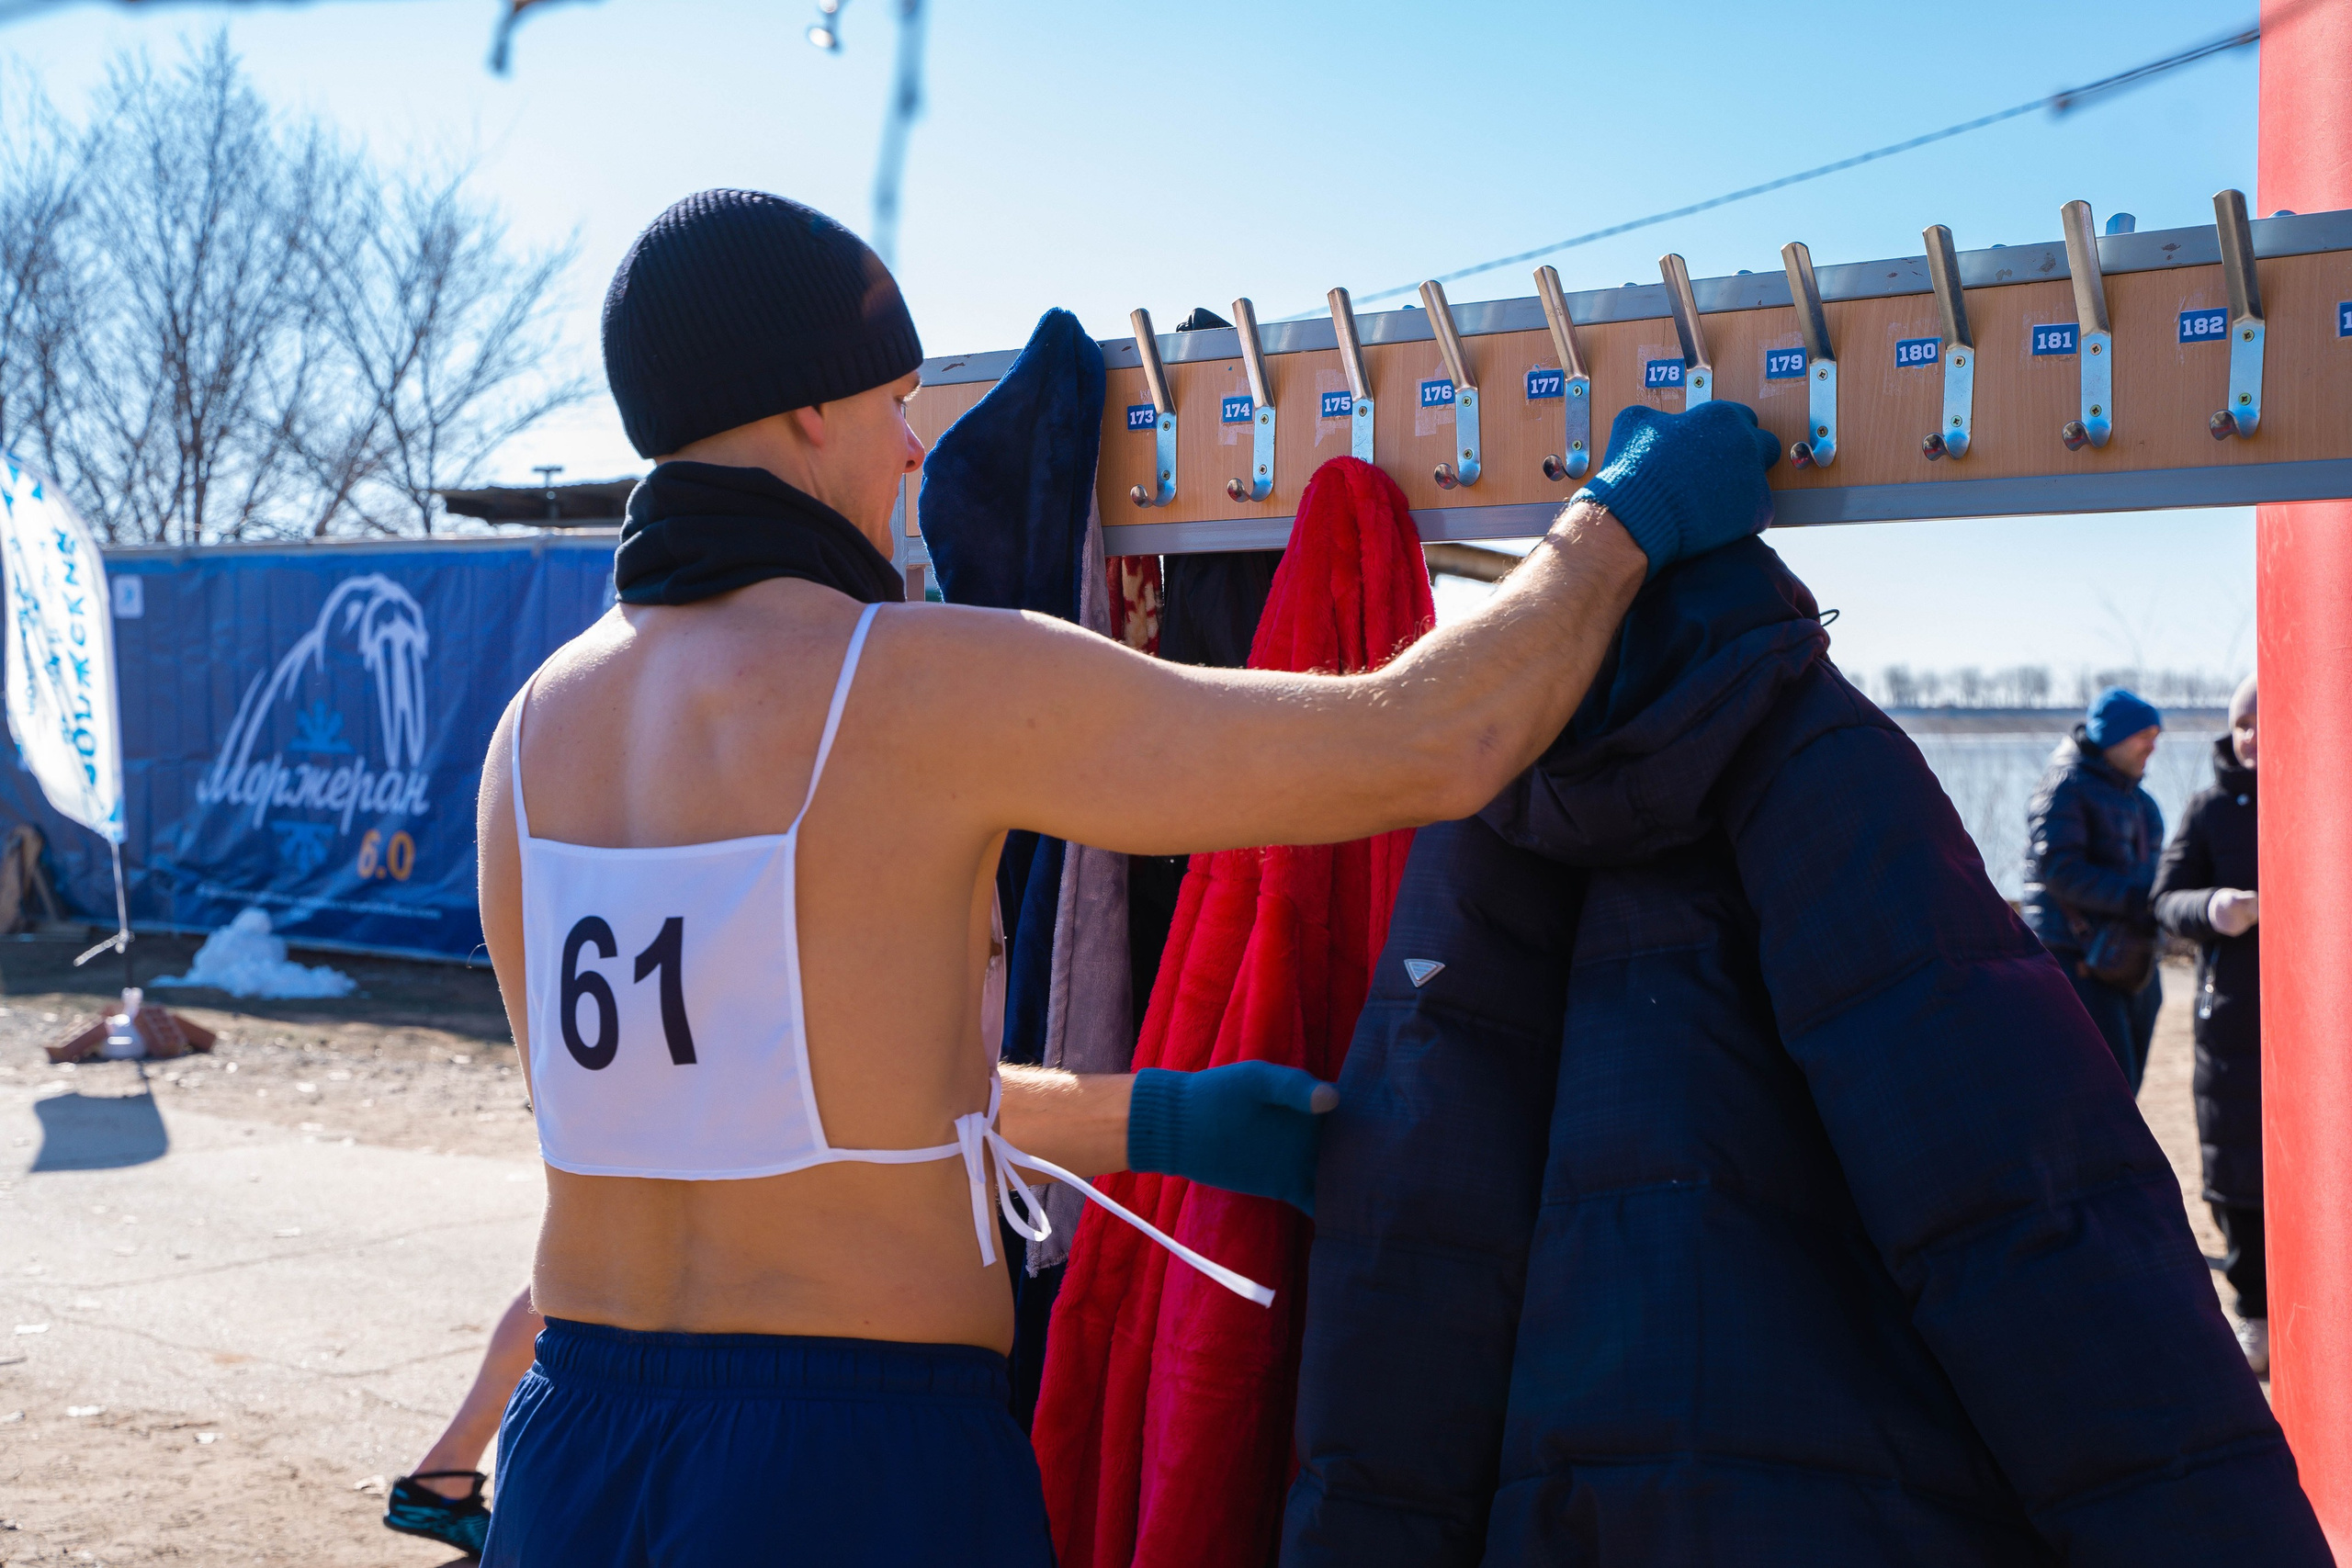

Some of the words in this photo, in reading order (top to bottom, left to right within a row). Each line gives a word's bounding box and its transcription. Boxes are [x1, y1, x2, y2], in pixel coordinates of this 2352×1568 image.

[2183, 316, 2224, 336] 182
[2037, 331, 2073, 350] 181
[1899, 343, 1937, 361] 180
[1770, 354, 1804, 373] 179
[1648, 366, 1679, 382] 178
[1424, 385, 1453, 402] 176
[1530, 377, 1560, 394] 177
[1225, 402, 1250, 418] 174
[1324, 396, 1351, 412] 175
[1129, 409, 1154, 425] 173
[356, 829, 416, 881] 6.0
[560, 916, 697, 1071] 61
